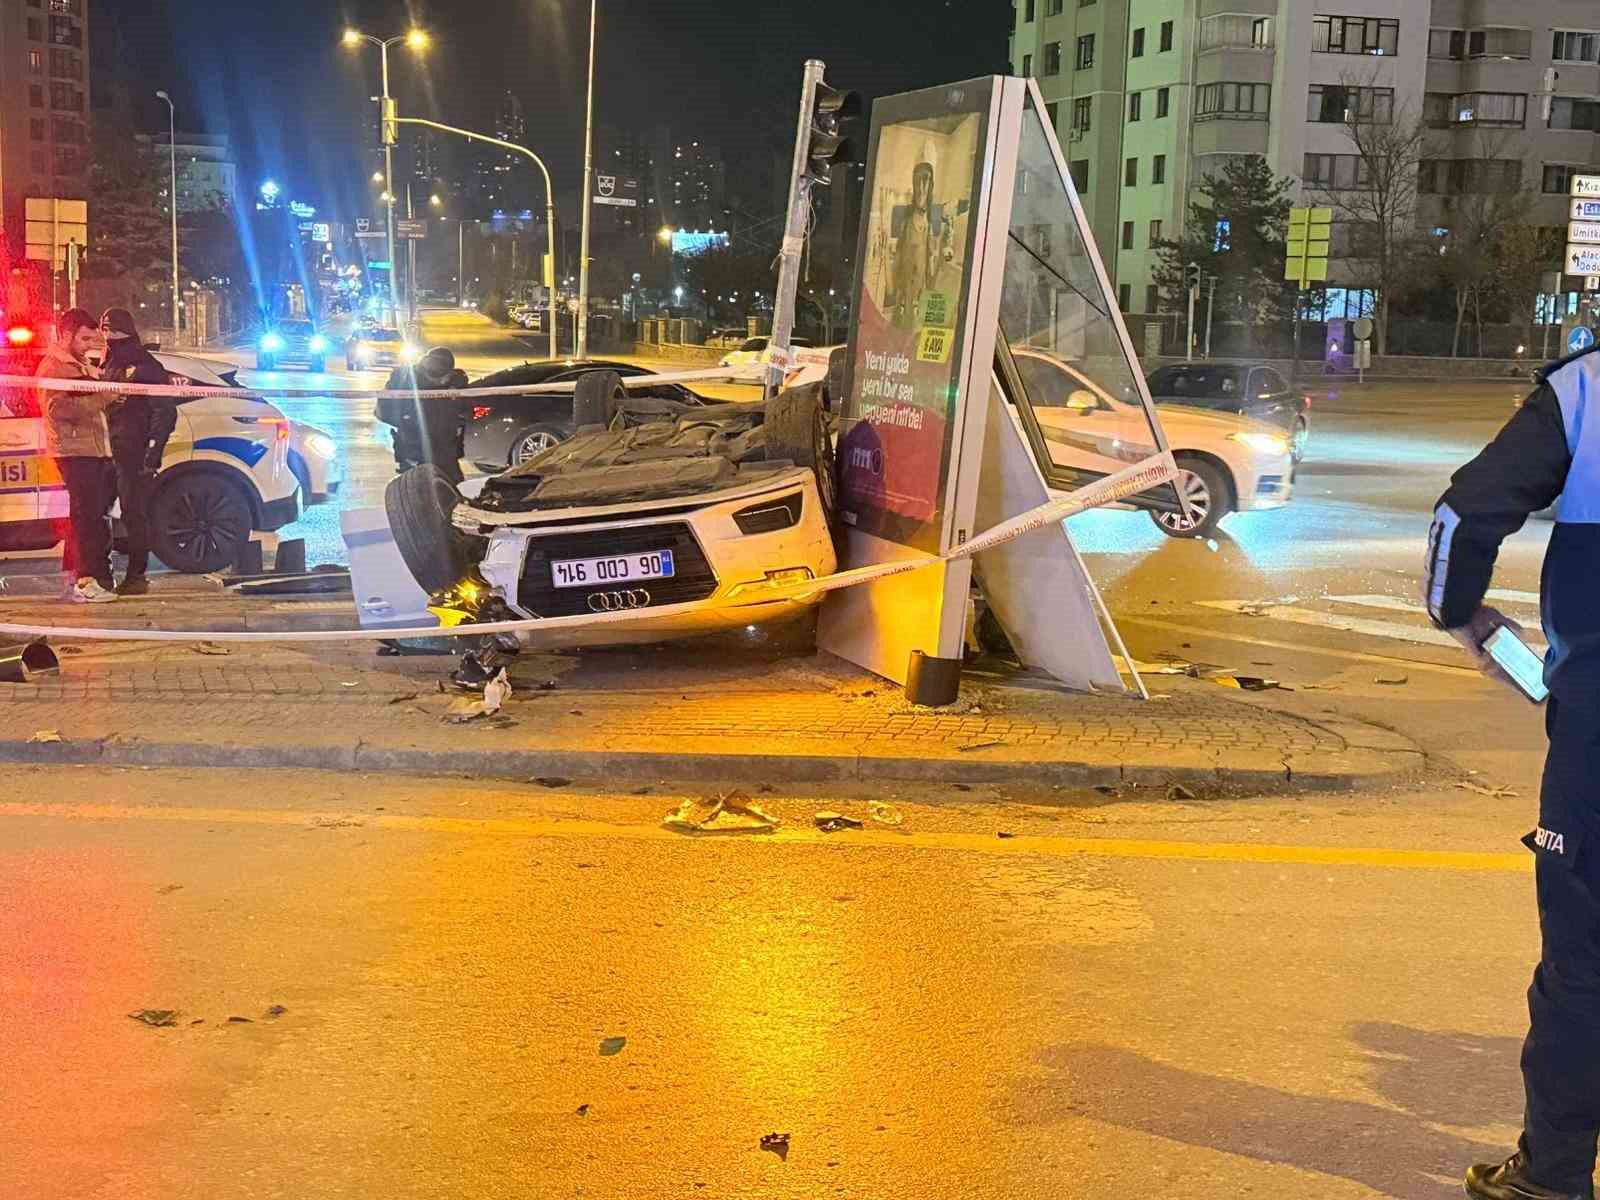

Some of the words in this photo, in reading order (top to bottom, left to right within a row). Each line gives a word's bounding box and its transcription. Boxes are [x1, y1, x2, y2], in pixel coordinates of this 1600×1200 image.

[865, 350, 886, 371] Yeni
[861, 375, 884, 397] yeni
[882, 375, 898, 398] bir
[558, 563, 587, 584] 914
[597, 559, 628, 579] CDD
[640, 555, 661, 575] 06
